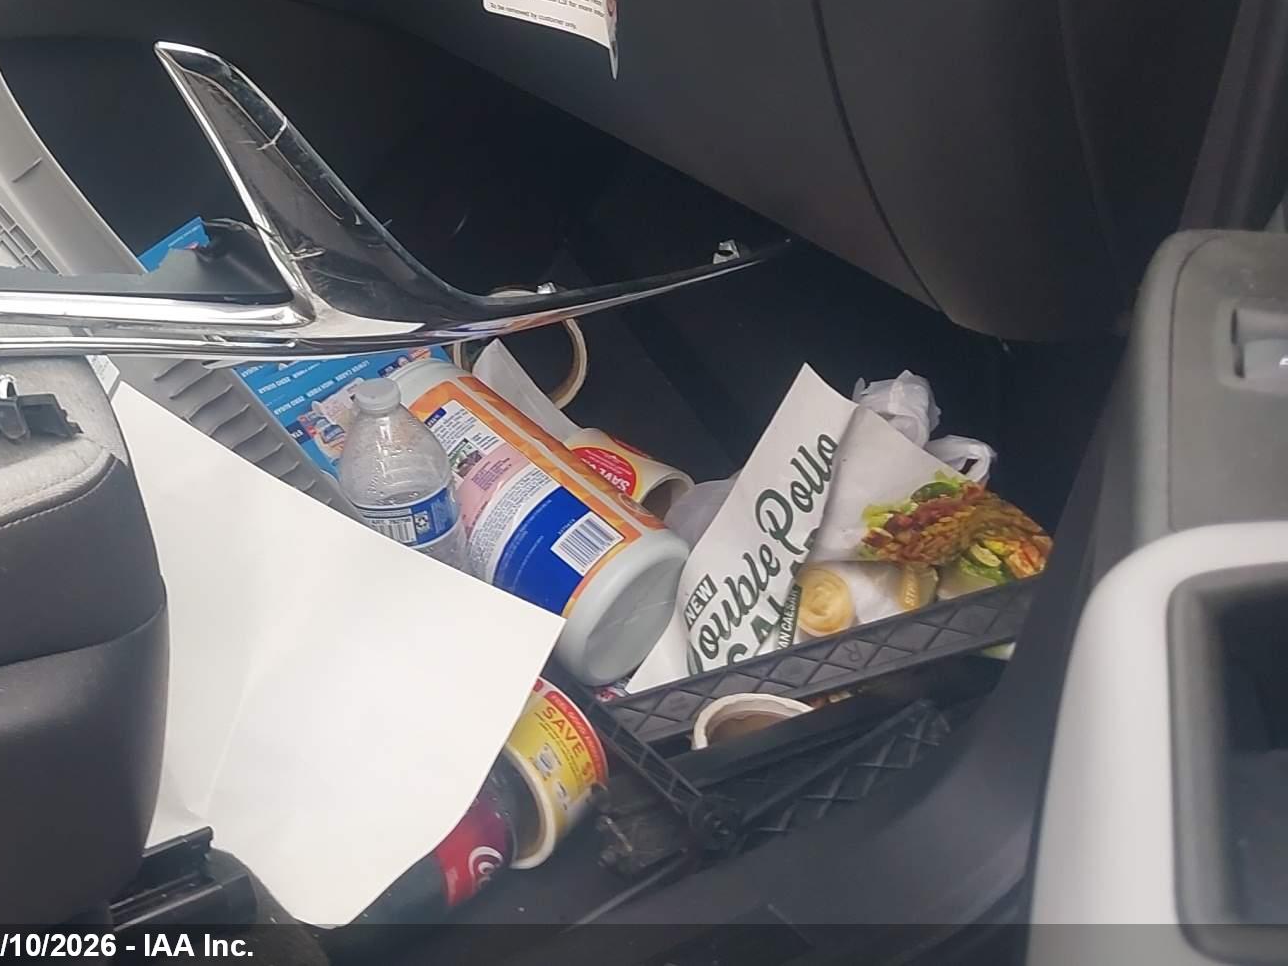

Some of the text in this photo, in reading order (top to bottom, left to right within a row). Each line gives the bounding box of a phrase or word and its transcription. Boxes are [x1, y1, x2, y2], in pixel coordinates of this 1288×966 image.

[506, 7, 530, 16] removed
[538, 15, 564, 26] customer
[569, 0, 577, 8] for
[578, 4, 592, 12] more
[755, 434, 838, 555] Pollo
[686, 580, 714, 626] NEW
[542, 707, 585, 758] SAVE
